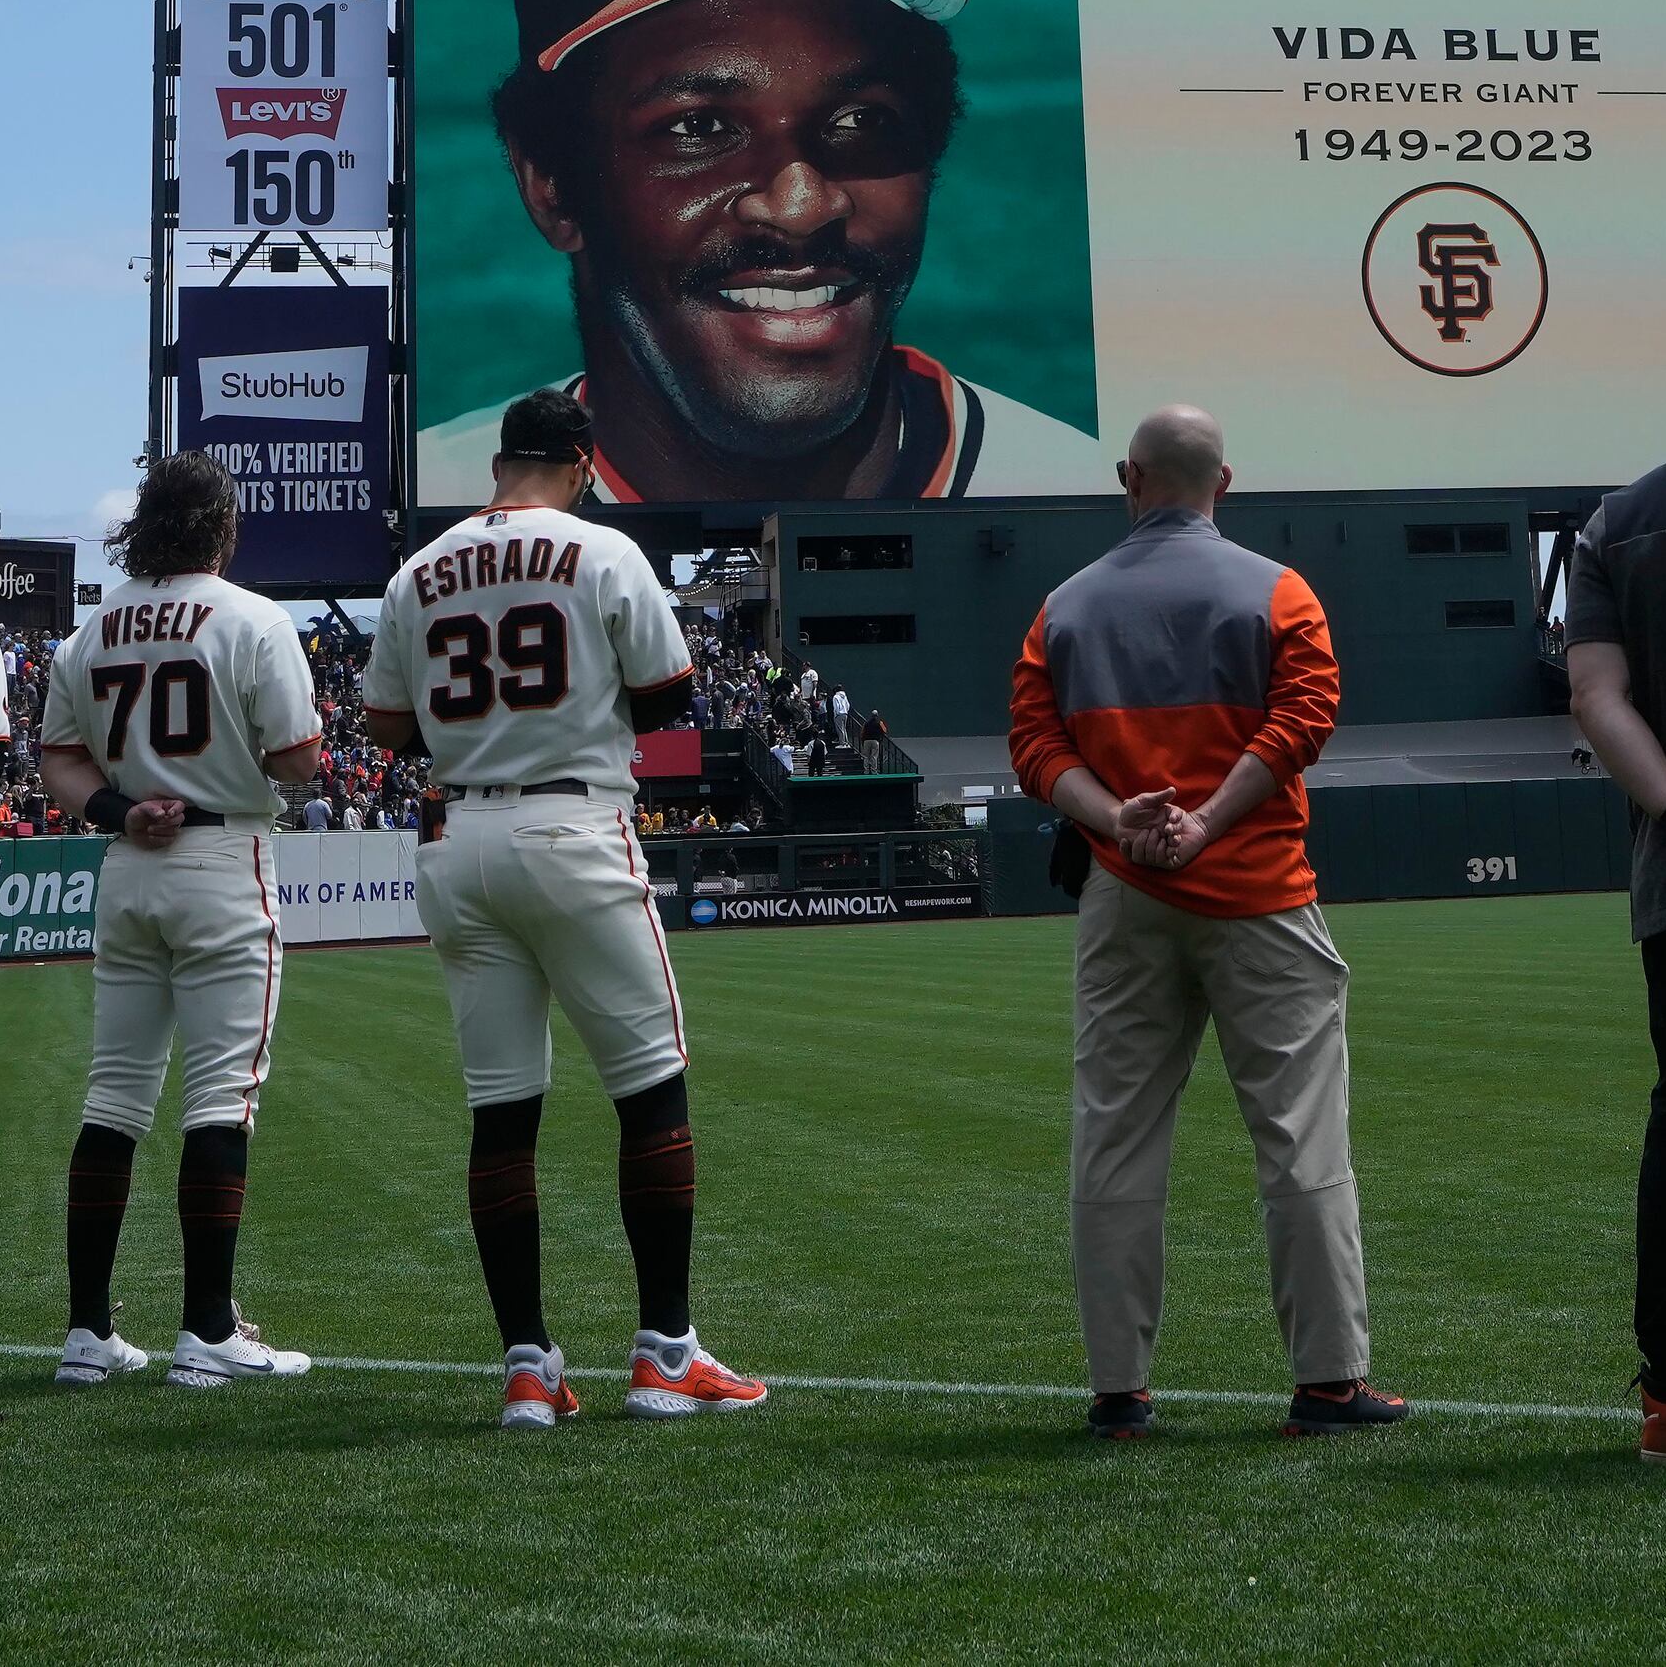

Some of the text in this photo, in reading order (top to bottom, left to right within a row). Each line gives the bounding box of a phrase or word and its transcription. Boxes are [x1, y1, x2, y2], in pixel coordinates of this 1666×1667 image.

[1271, 27, 1601, 62] VIDA BLUE
[1303, 82, 1579, 103] FOREVER GIANT
[1294, 128, 1593, 162] 1949-2023
[220, 372, 346, 398] StubHub
[268, 442, 363, 474] VERIFIED
[235, 480, 371, 513] NTS TICKETS
[413, 538, 582, 608] ESTRADA
[102, 602, 213, 650] WISELY
[426, 601, 570, 724] 39
[91, 659, 212, 761] 70
[1466, 856, 1517, 883] 391
[278, 881, 415, 904] NK OF AMER
[721, 894, 972, 920] KONICA MINOLTA RESHAPEWORK.COM
